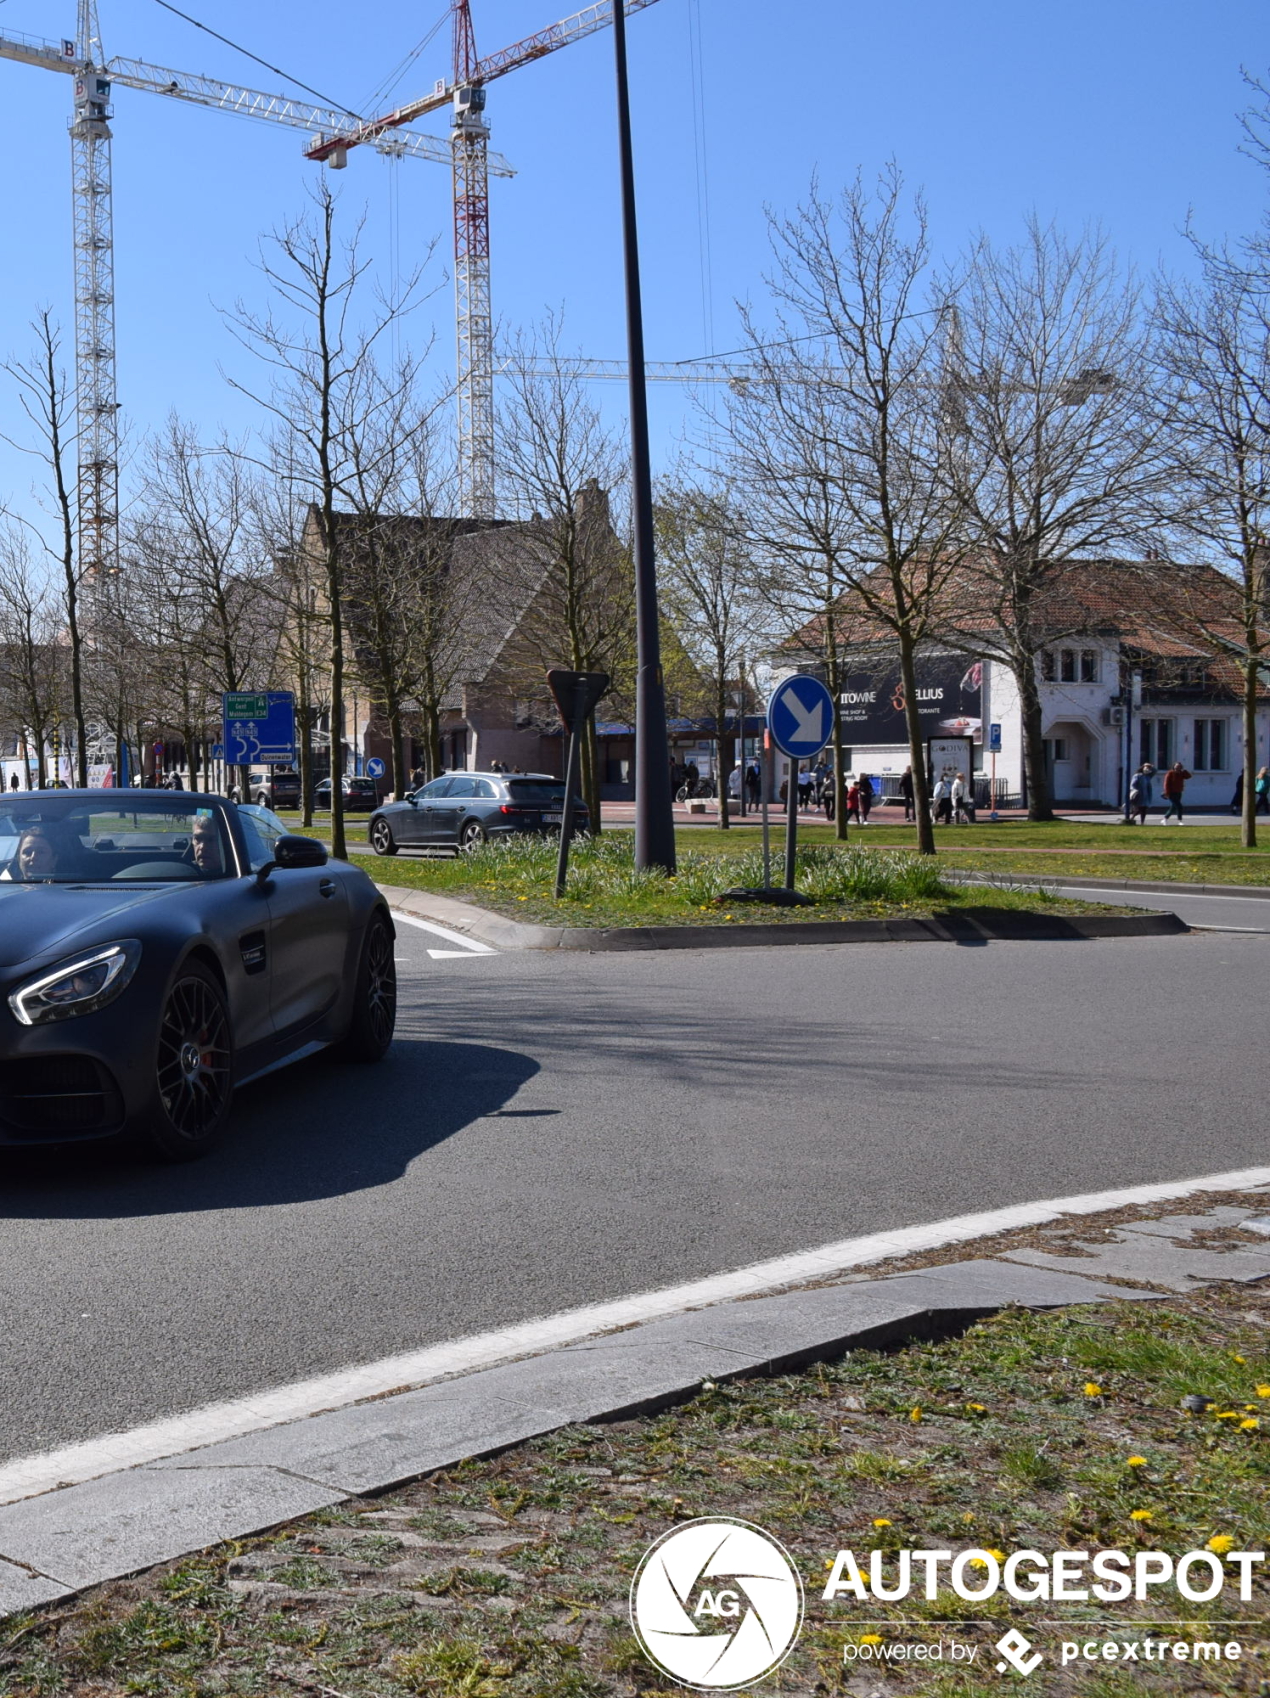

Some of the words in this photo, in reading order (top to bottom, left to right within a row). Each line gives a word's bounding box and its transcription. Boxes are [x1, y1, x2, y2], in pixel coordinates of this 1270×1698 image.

[64, 41, 74, 57] B
[76, 80, 84, 95] B
[436, 81, 443, 93] B
[915, 688, 944, 700] ELLIUS
[992, 726, 1000, 740] P
[932, 744, 969, 753] GODIVA
